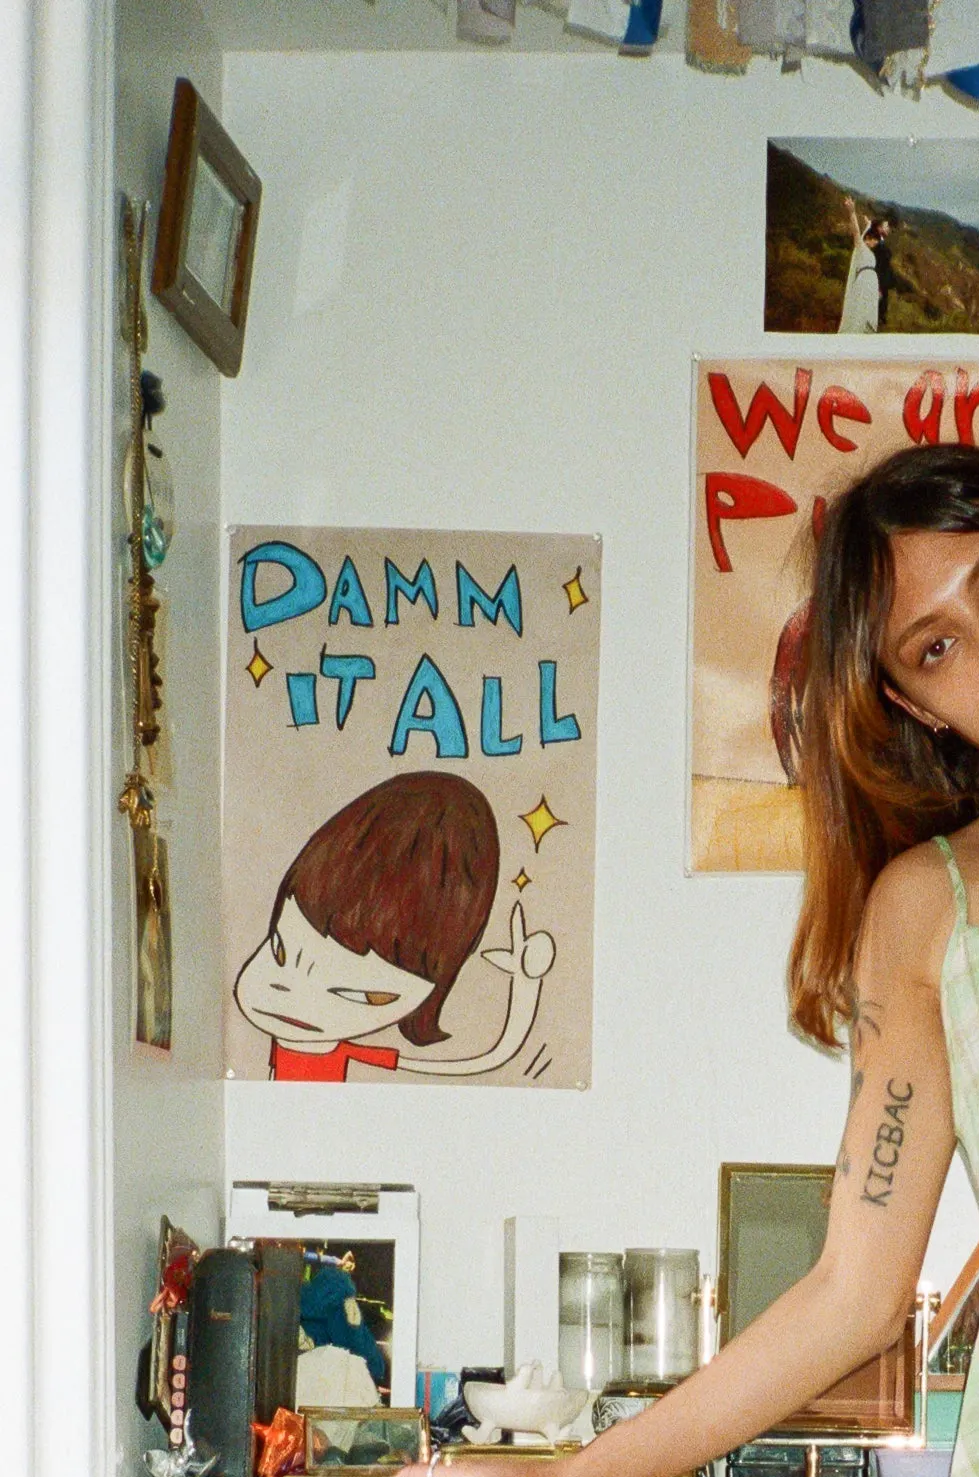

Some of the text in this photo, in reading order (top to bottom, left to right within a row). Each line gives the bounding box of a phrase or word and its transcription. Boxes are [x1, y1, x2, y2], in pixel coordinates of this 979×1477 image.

[708, 368, 872, 460] We
[239, 541, 523, 637] DAMM
[287, 644, 582, 758] IT ALL
[861, 1078, 913, 1207] KICBAC
